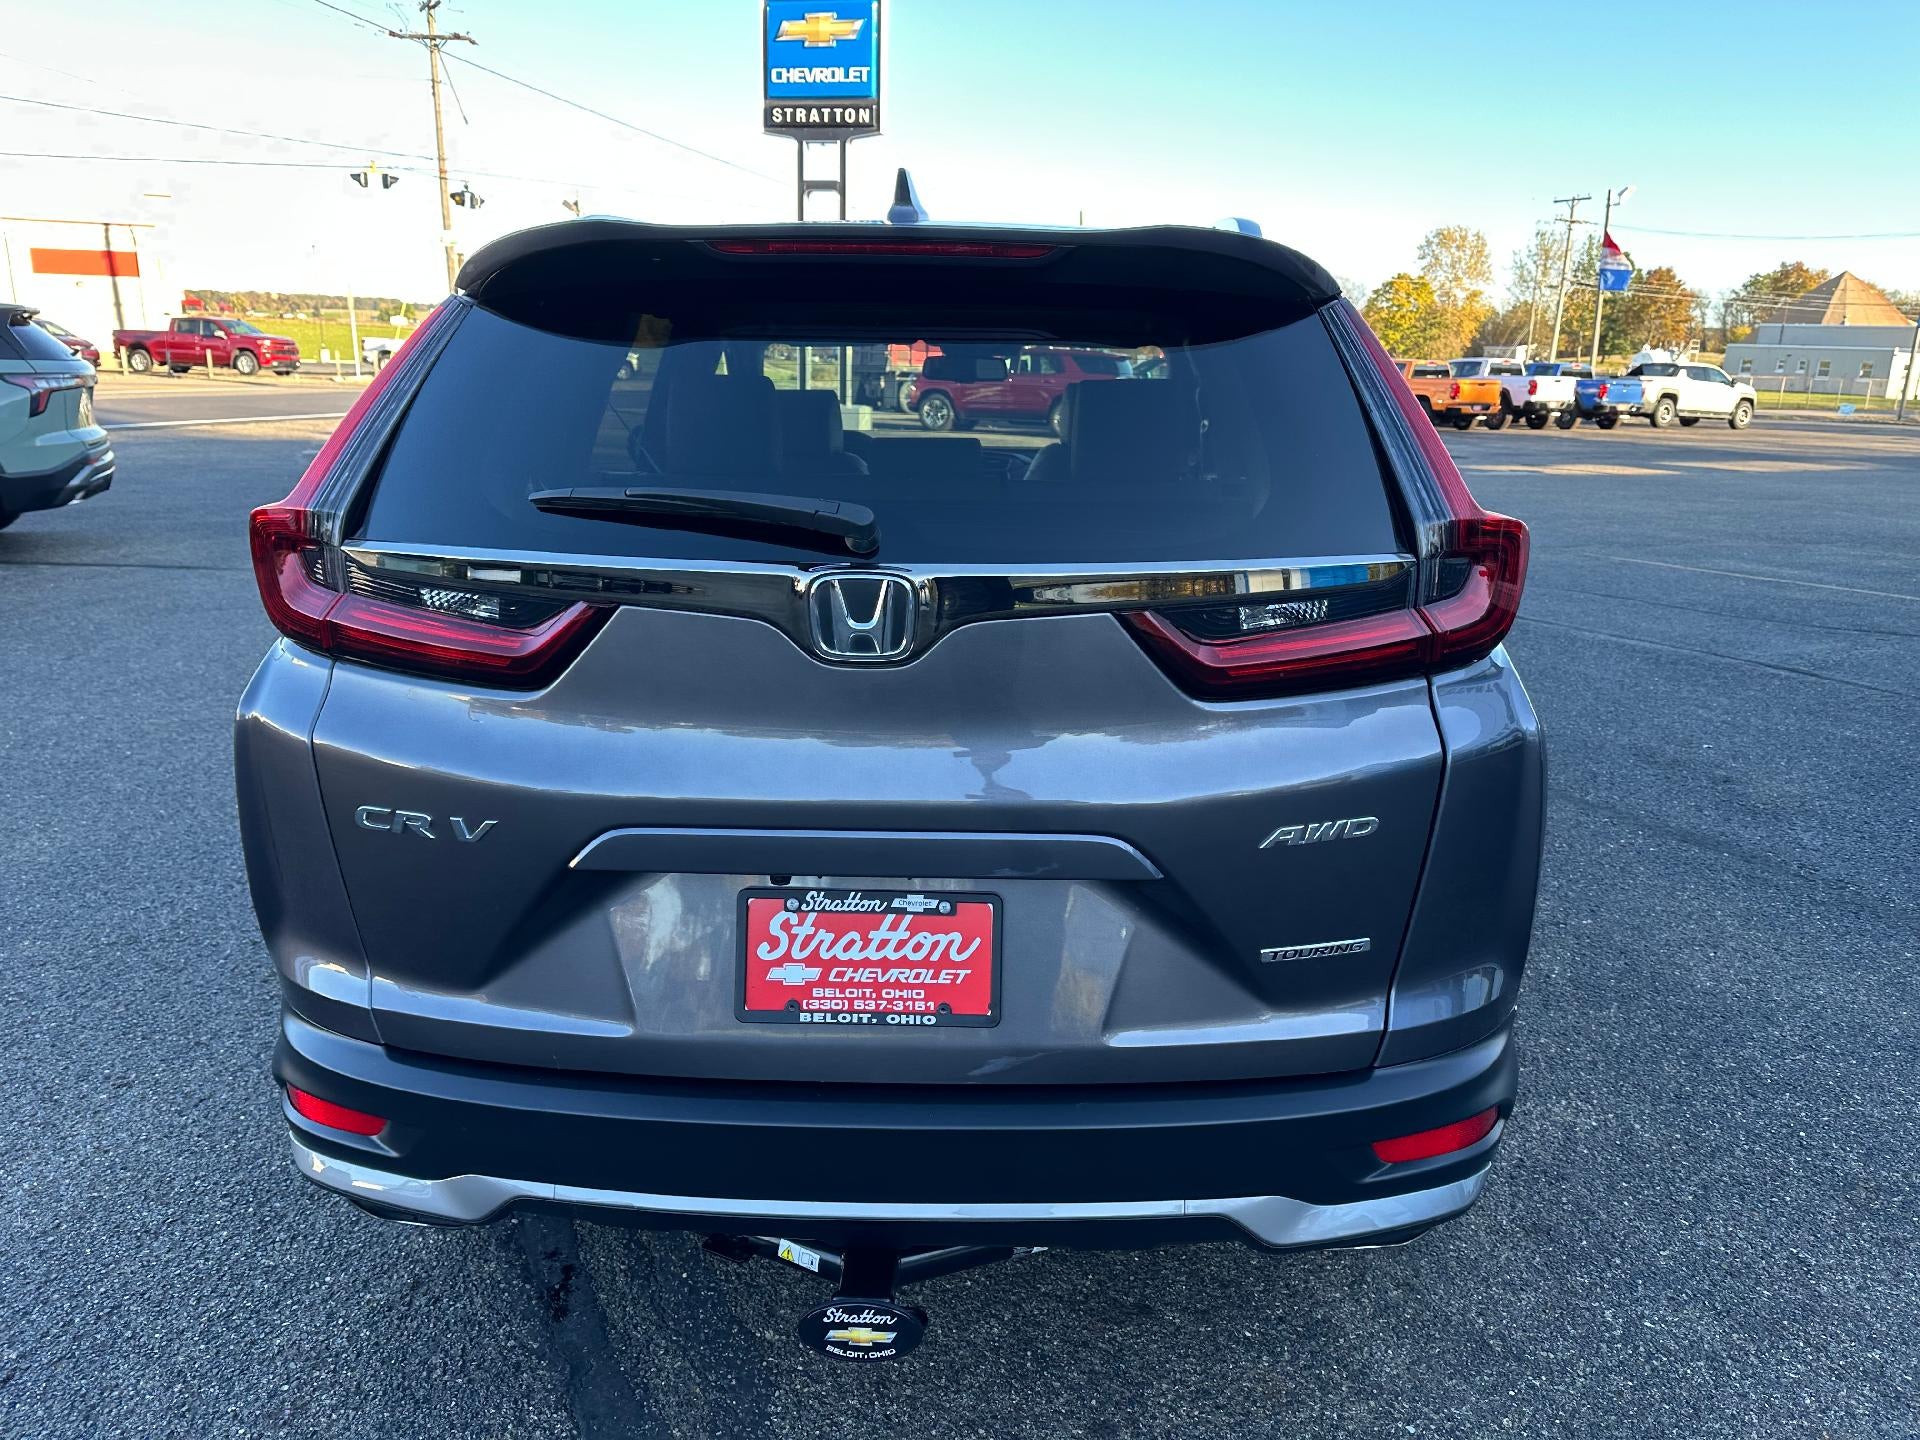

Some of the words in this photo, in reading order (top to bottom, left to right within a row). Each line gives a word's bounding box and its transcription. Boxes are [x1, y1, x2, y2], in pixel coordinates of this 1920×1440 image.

[770, 66, 871, 83] CHEVROLET
[772, 107, 870, 123] STRATTON
[1258, 816, 1380, 849] AWD
[801, 891, 888, 913] Stratton
[898, 899, 933, 907] Chevrolet
[756, 911, 982, 962] Stratton
[1268, 942, 1365, 962] TOURING
[828, 967, 972, 985] CHEVROLET
[812, 987, 877, 999] BELOIT,
[881, 988, 925, 999] OHIO
[802, 1000, 849, 1011] (330)
[799, 1013, 877, 1025] BELOIT,
[885, 1014, 937, 1026] OHIO
[822, 1307, 898, 1325] Stratton
[825, 1344, 868, 1359] BELOIT,
[868, 1348, 896, 1359] OHIO
